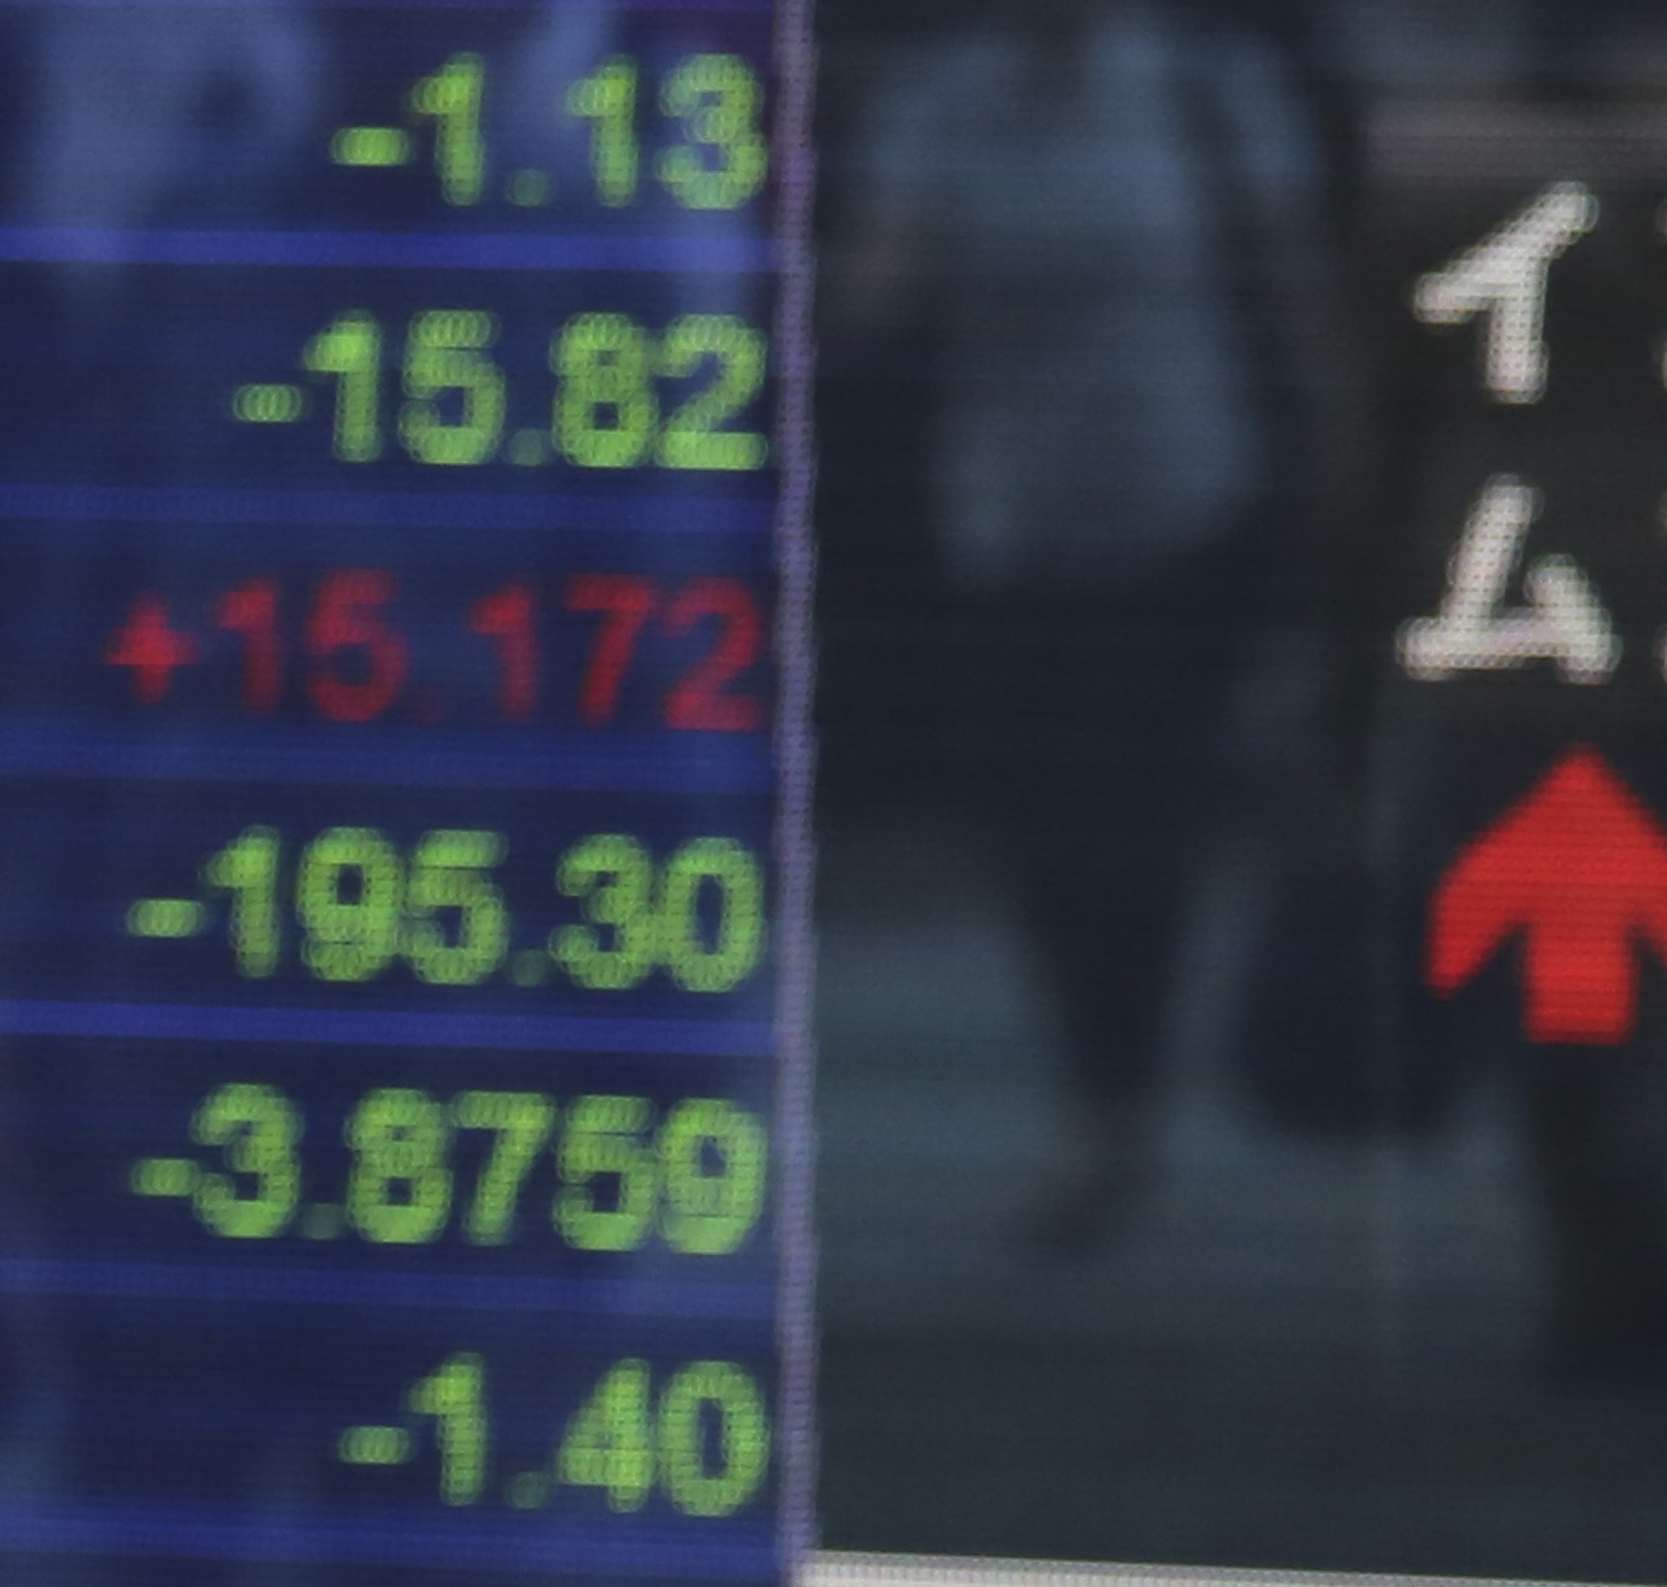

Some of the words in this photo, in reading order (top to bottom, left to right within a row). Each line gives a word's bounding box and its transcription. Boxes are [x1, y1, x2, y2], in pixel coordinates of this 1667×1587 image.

[331, 52, 767, 209] -1.13
[1412, 181, 1667, 404] イ
[229, 309, 768, 470] -15.82
[102, 567, 766, 731] +15.172
[126, 826, 767, 992] -195.30
[130, 1082, 768, 1256] -3.8759
[336, 1352, 770, 1517] -1.40
